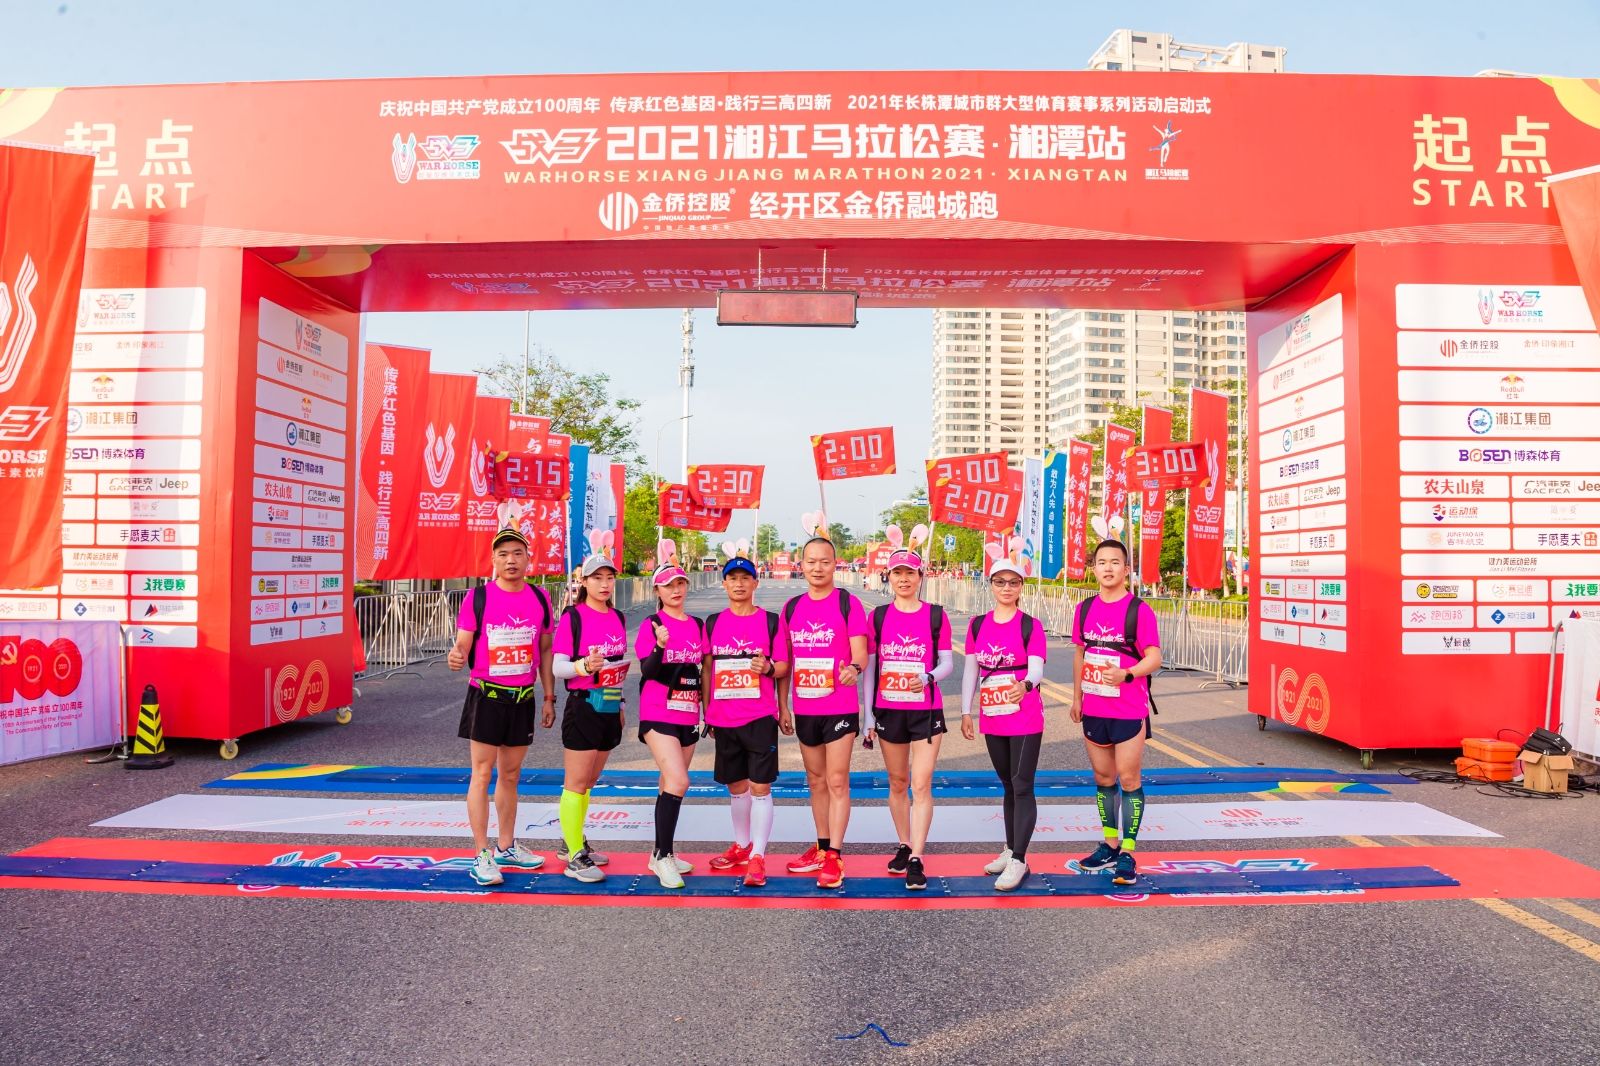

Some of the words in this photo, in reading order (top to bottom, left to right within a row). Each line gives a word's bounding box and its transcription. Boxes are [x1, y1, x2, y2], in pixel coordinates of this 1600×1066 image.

[379, 97, 600, 117] 庆祝中国共产党成立100周年
[610, 94, 832, 113] 传承红色基因·践行三高四新
[848, 94, 1211, 115] 2021年长株潭城市群大型体育赛事系列活动启动式
[1412, 113, 1553, 174] 起点
[419, 161, 441, 170] WAR
[443, 160, 480, 170] HORSE
[504, 170, 629, 183] WARHORSE
[637, 169, 708, 182] XIANG
[715, 168, 784, 181] JIANG
[794, 167, 925, 181] MARATHON
[1008, 168, 1128, 182] XIANGTAN
[90, 182, 195, 210] TART
[1412, 178, 1551, 208] START
[641, 192, 731, 213] 金侨控股
[750, 189, 999, 219] 经开区金侨融城跑
[658, 214, 686, 222] JINQIAO
[1497, 310, 1514, 318] WAR
[1460, 339, 1499, 350] 金侨控股
[86, 411, 138, 425] 湘江集团
[1495, 412, 1551, 426] 湘江集团
[0, 449, 48, 464] ORSE
[67, 448, 98, 460] SEN
[101, 448, 145, 460] 博森体育
[823, 434, 883, 464] 2:00
[1458, 448, 1512, 462] BOSEN
[1514, 449, 1561, 462] 博森体育
[372, 367, 399, 560] 传承红色基因·践行三高四新
[937, 458, 1000, 483] 3:00
[1136, 448, 1197, 477] 3:00
[506, 458, 561, 486] 2:15
[160, 478, 189, 490] Jeep
[697, 470, 753, 494] 2:30
[1424, 479, 1485, 495] 农夫山泉
[1578, 480, 1600, 491] Jee
[264, 482, 293, 499] 农夫山泉
[1326, 485, 1341, 496] Jeep
[944, 483, 1009, 518] 2:00
[1449, 506, 1478, 516] 运动保
[1538, 533, 1581, 546] 手感麦夫
[496, 650, 528, 664] 2:15
[602, 669, 626, 687] 2:15
[720, 674, 752, 688] 2:30
[798, 673, 827, 687] 2:00
[1084, 667, 1105, 682] 3:0
[280, 685, 295, 701] 1921
[307, 679, 323, 695] 2021
[981, 690, 1010, 705] 3:00
[1282, 690, 1296, 703] 1921
[1306, 696, 1322, 711] 2021
[0, 701, 84, 720] 祝中国共产党成立100周年
[1128, 798, 1143, 834] Kalenji
